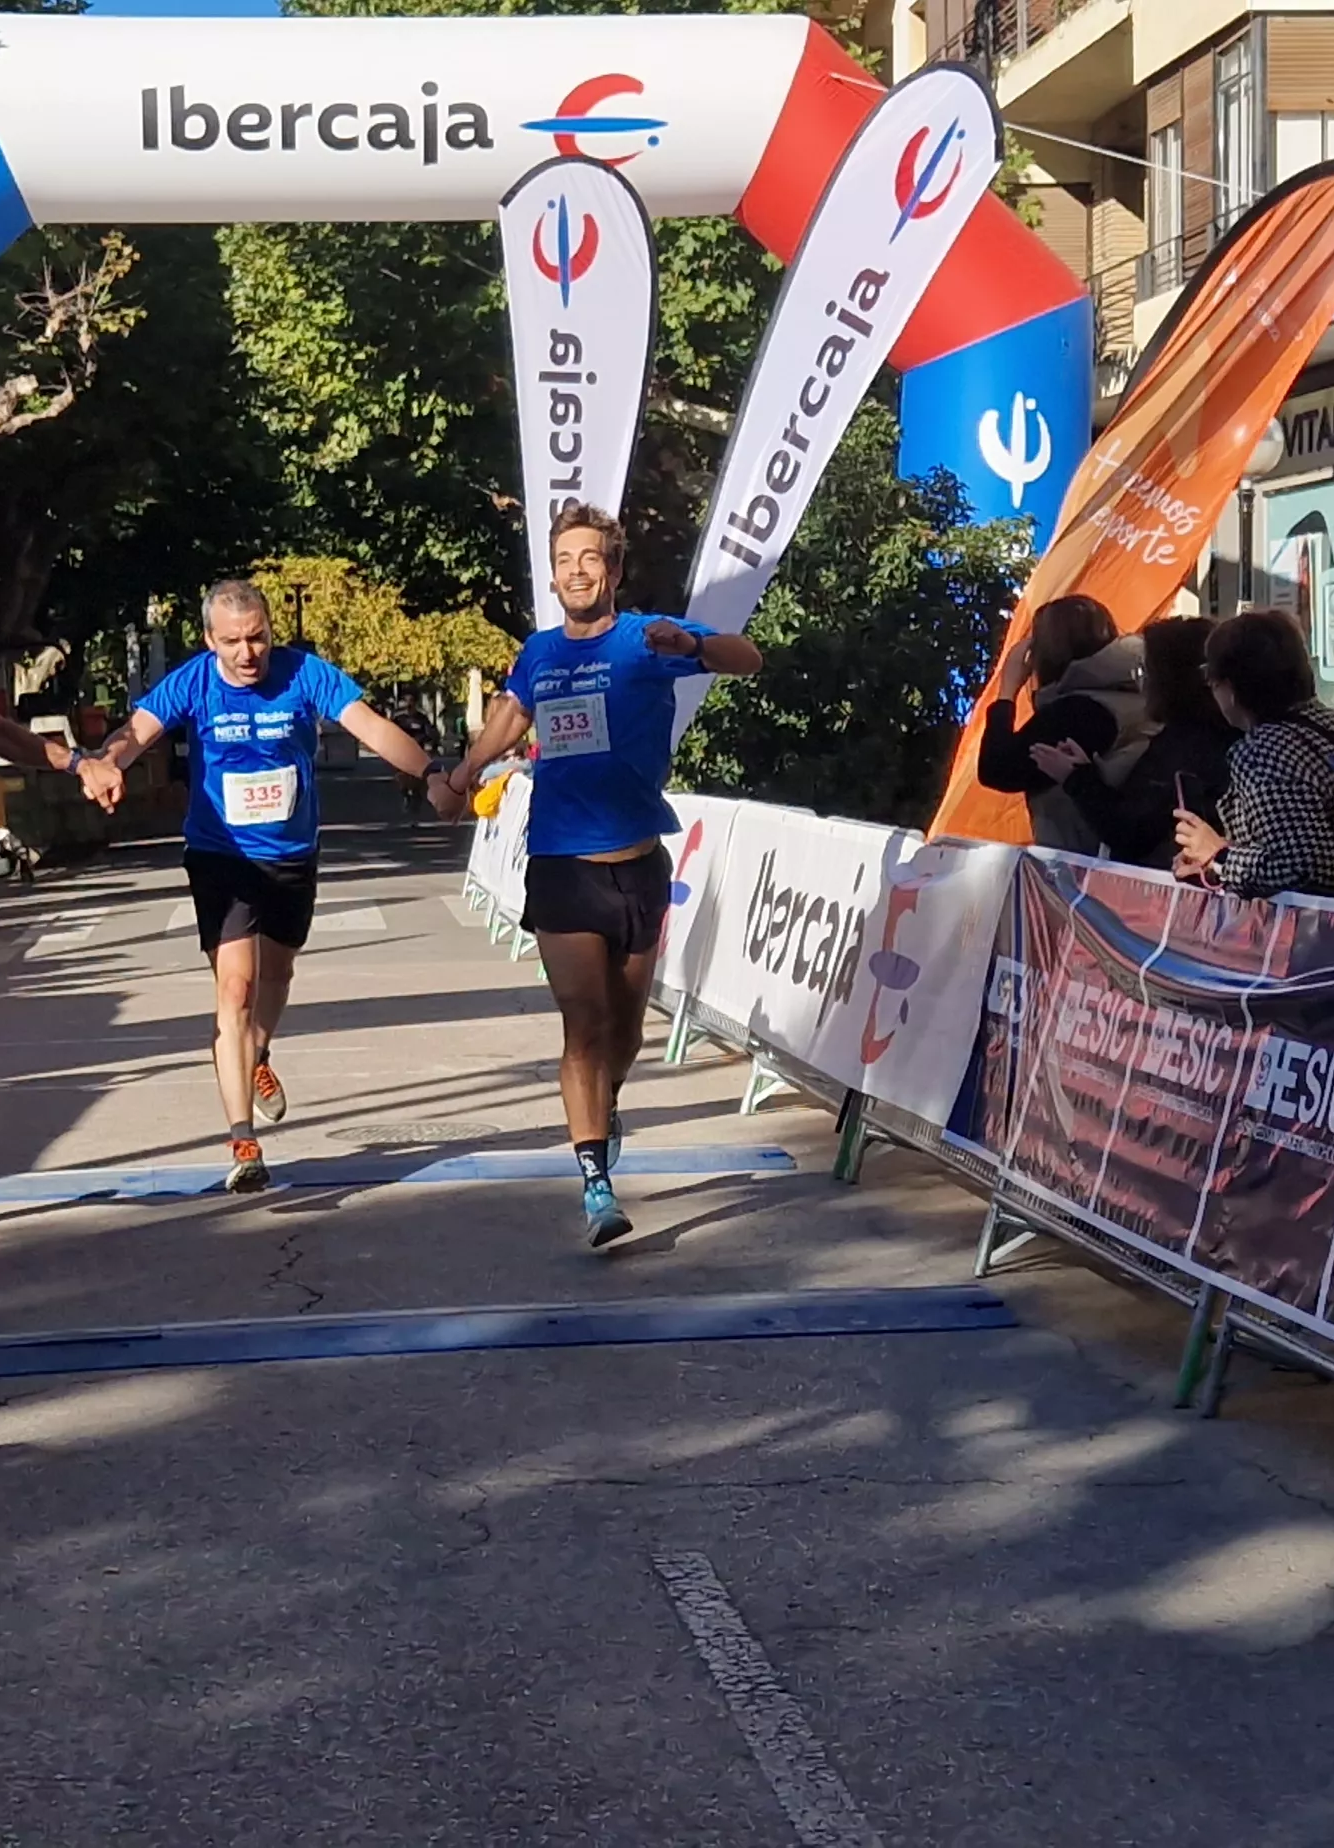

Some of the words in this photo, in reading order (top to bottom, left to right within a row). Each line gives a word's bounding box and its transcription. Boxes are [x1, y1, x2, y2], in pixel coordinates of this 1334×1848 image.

[141, 81, 495, 166] Ibercaja
[719, 268, 891, 569] Ibercaja
[550, 712, 590, 733] 333
[244, 785, 283, 802] 335
[743, 848, 865, 1029] Ibercaja
[1071, 984, 1134, 1062] ESIC
[1165, 1012, 1233, 1093] ESIC
